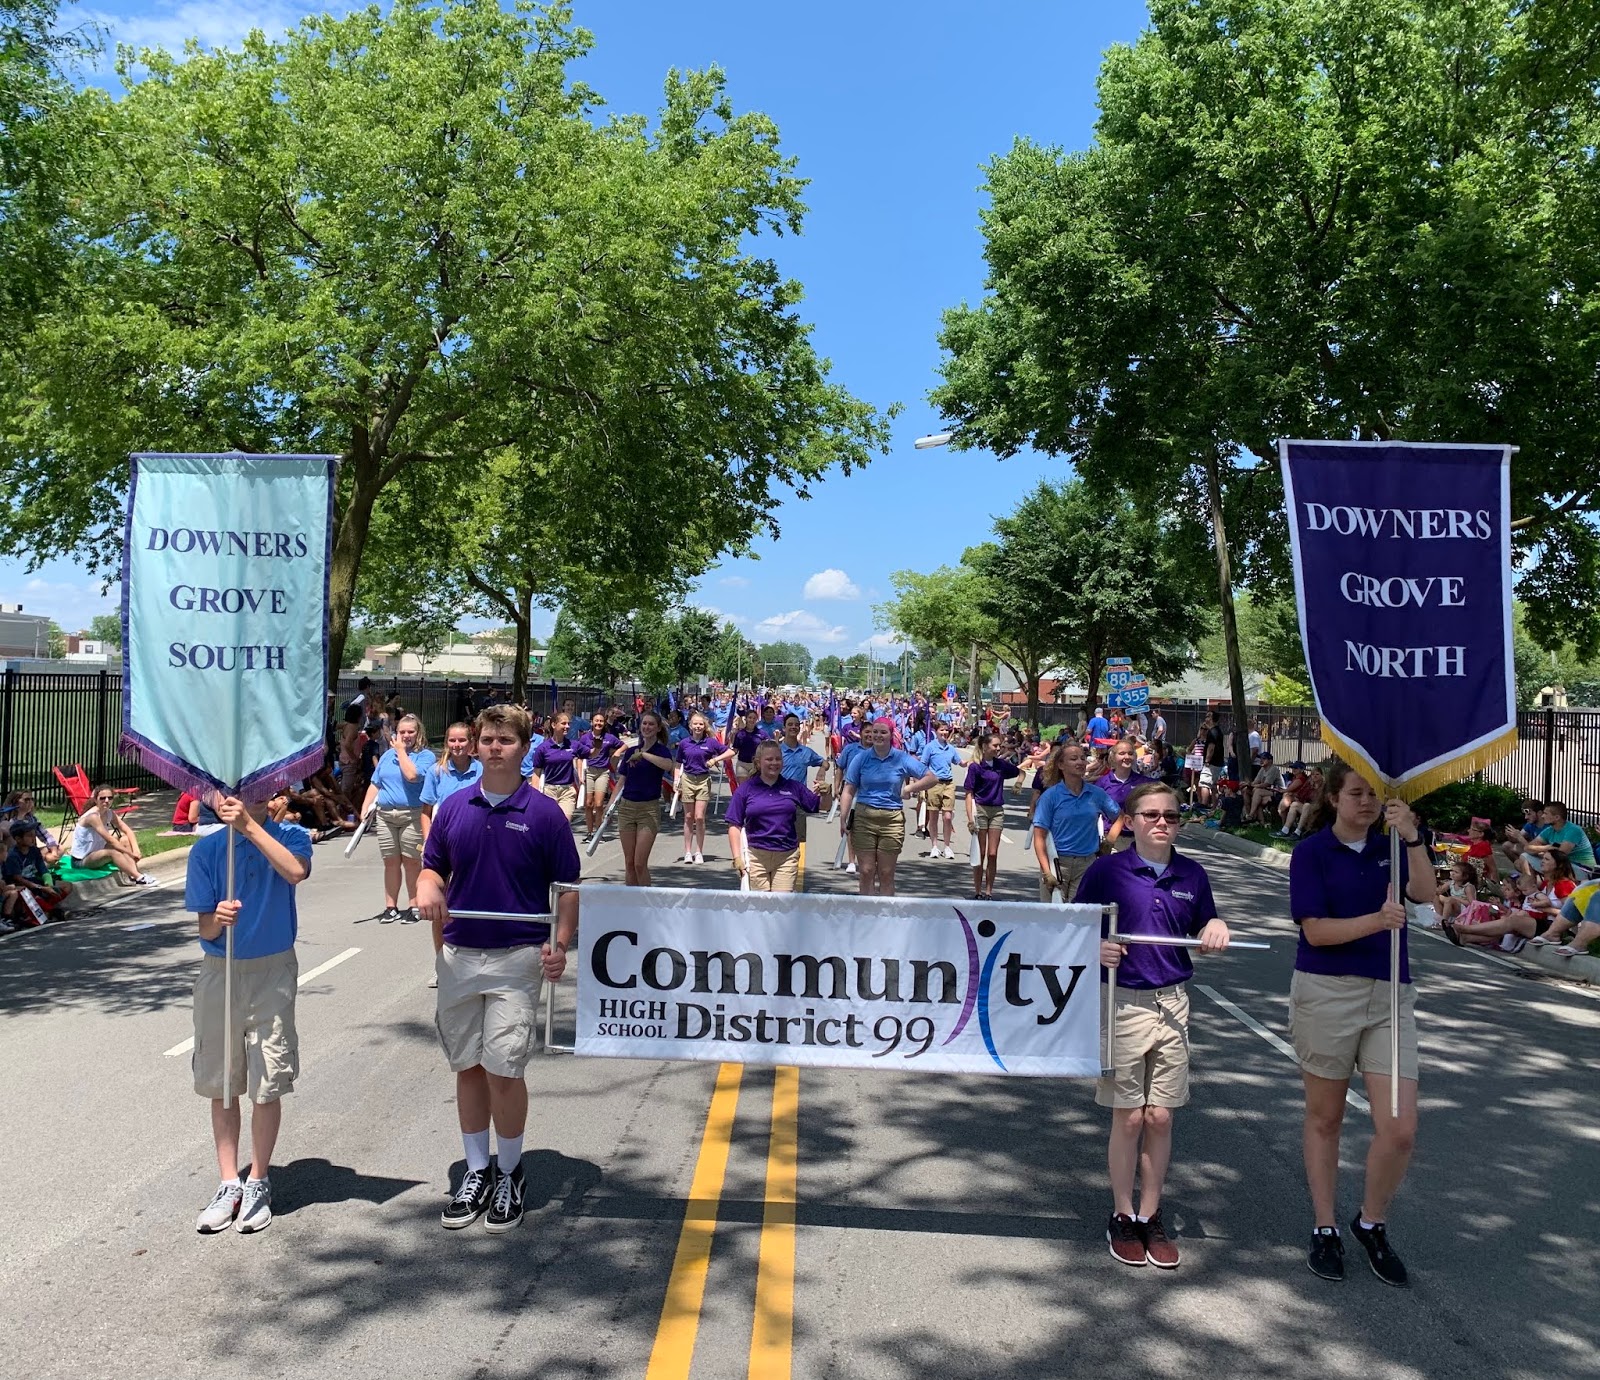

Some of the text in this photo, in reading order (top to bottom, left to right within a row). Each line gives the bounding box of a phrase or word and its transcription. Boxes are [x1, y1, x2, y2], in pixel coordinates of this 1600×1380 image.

[1303, 502, 1492, 540] DOWNERS
[145, 526, 308, 558] DOWNERS
[169, 584, 288, 615] GROVE
[1340, 571, 1467, 608] GROVE
[168, 642, 288, 672] SOUTH
[1344, 639, 1467, 678] NORTH
[1110, 673, 1127, 687] 88
[1124, 689, 1148, 703] 355
[591, 918, 1087, 1030] Community
[599, 998, 667, 1020] HIGH
[597, 1022, 667, 1038] SCHOOL
[674, 1002, 935, 1059] District 99
